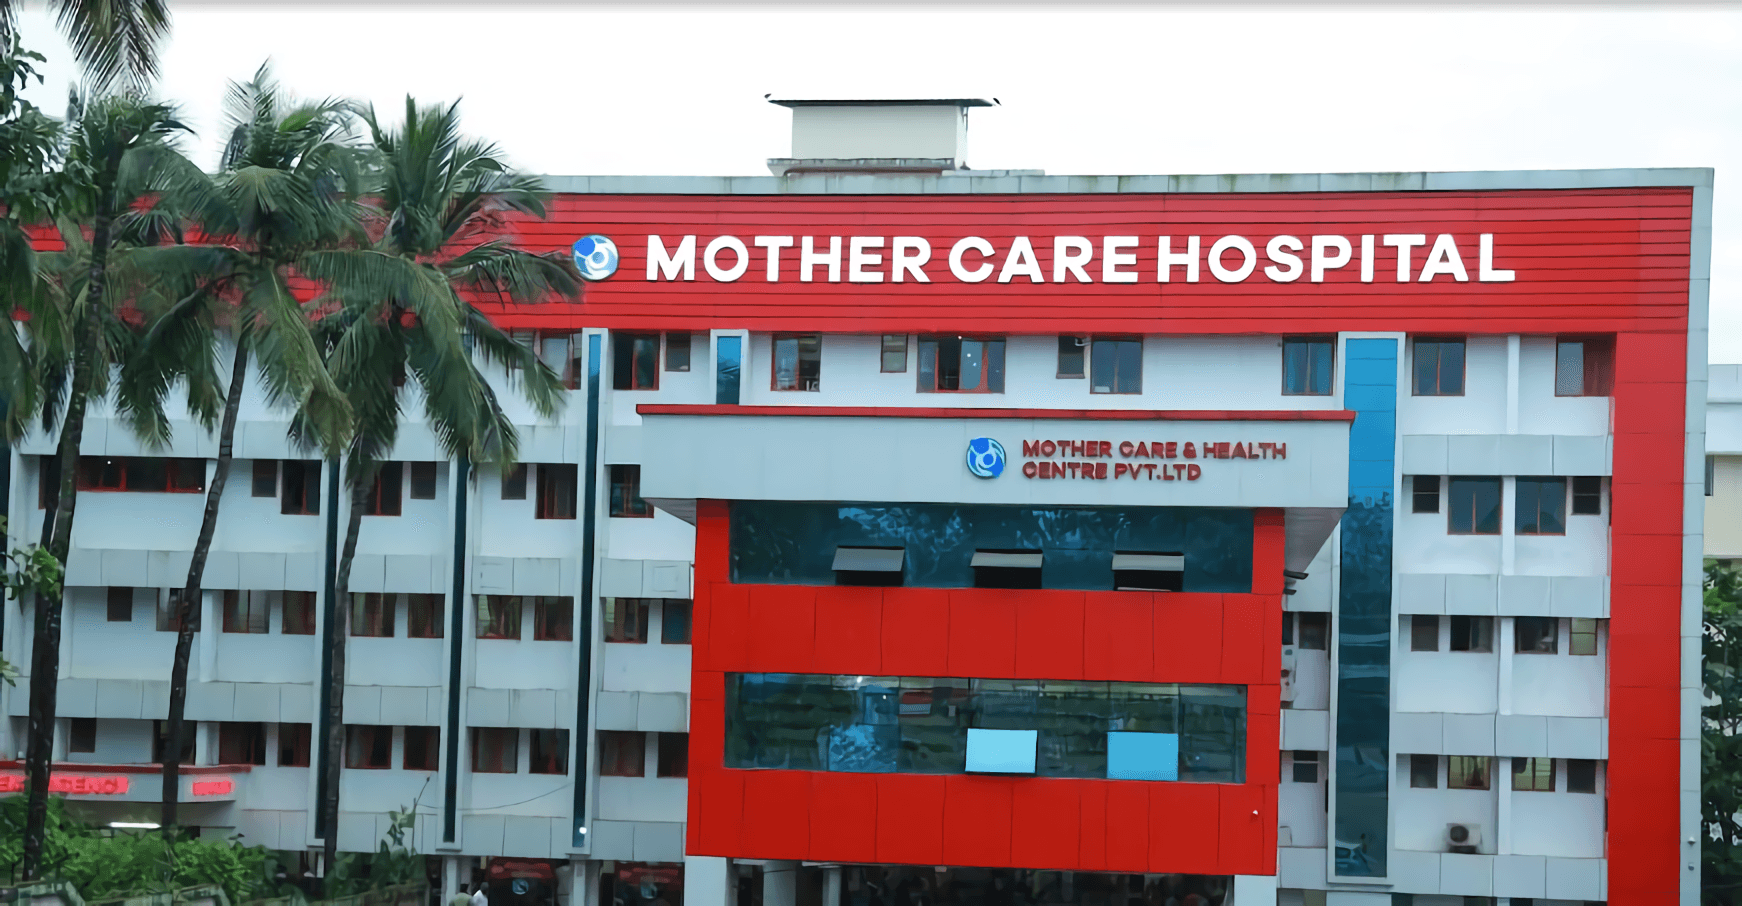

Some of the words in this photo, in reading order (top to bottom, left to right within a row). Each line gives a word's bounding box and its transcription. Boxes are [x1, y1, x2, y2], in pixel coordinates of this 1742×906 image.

[646, 235, 931, 283] MOTHER
[949, 235, 1139, 283] CARE
[1157, 234, 1516, 283] HOSPITAL
[1022, 439, 1113, 457] MOTHER
[1119, 440, 1178, 459] CARE
[1182, 441, 1198, 459] &
[1203, 441, 1287, 460] HEALTH
[1022, 461, 1108, 480] CENTRE
[1114, 462, 1202, 481] PVT.LTD
